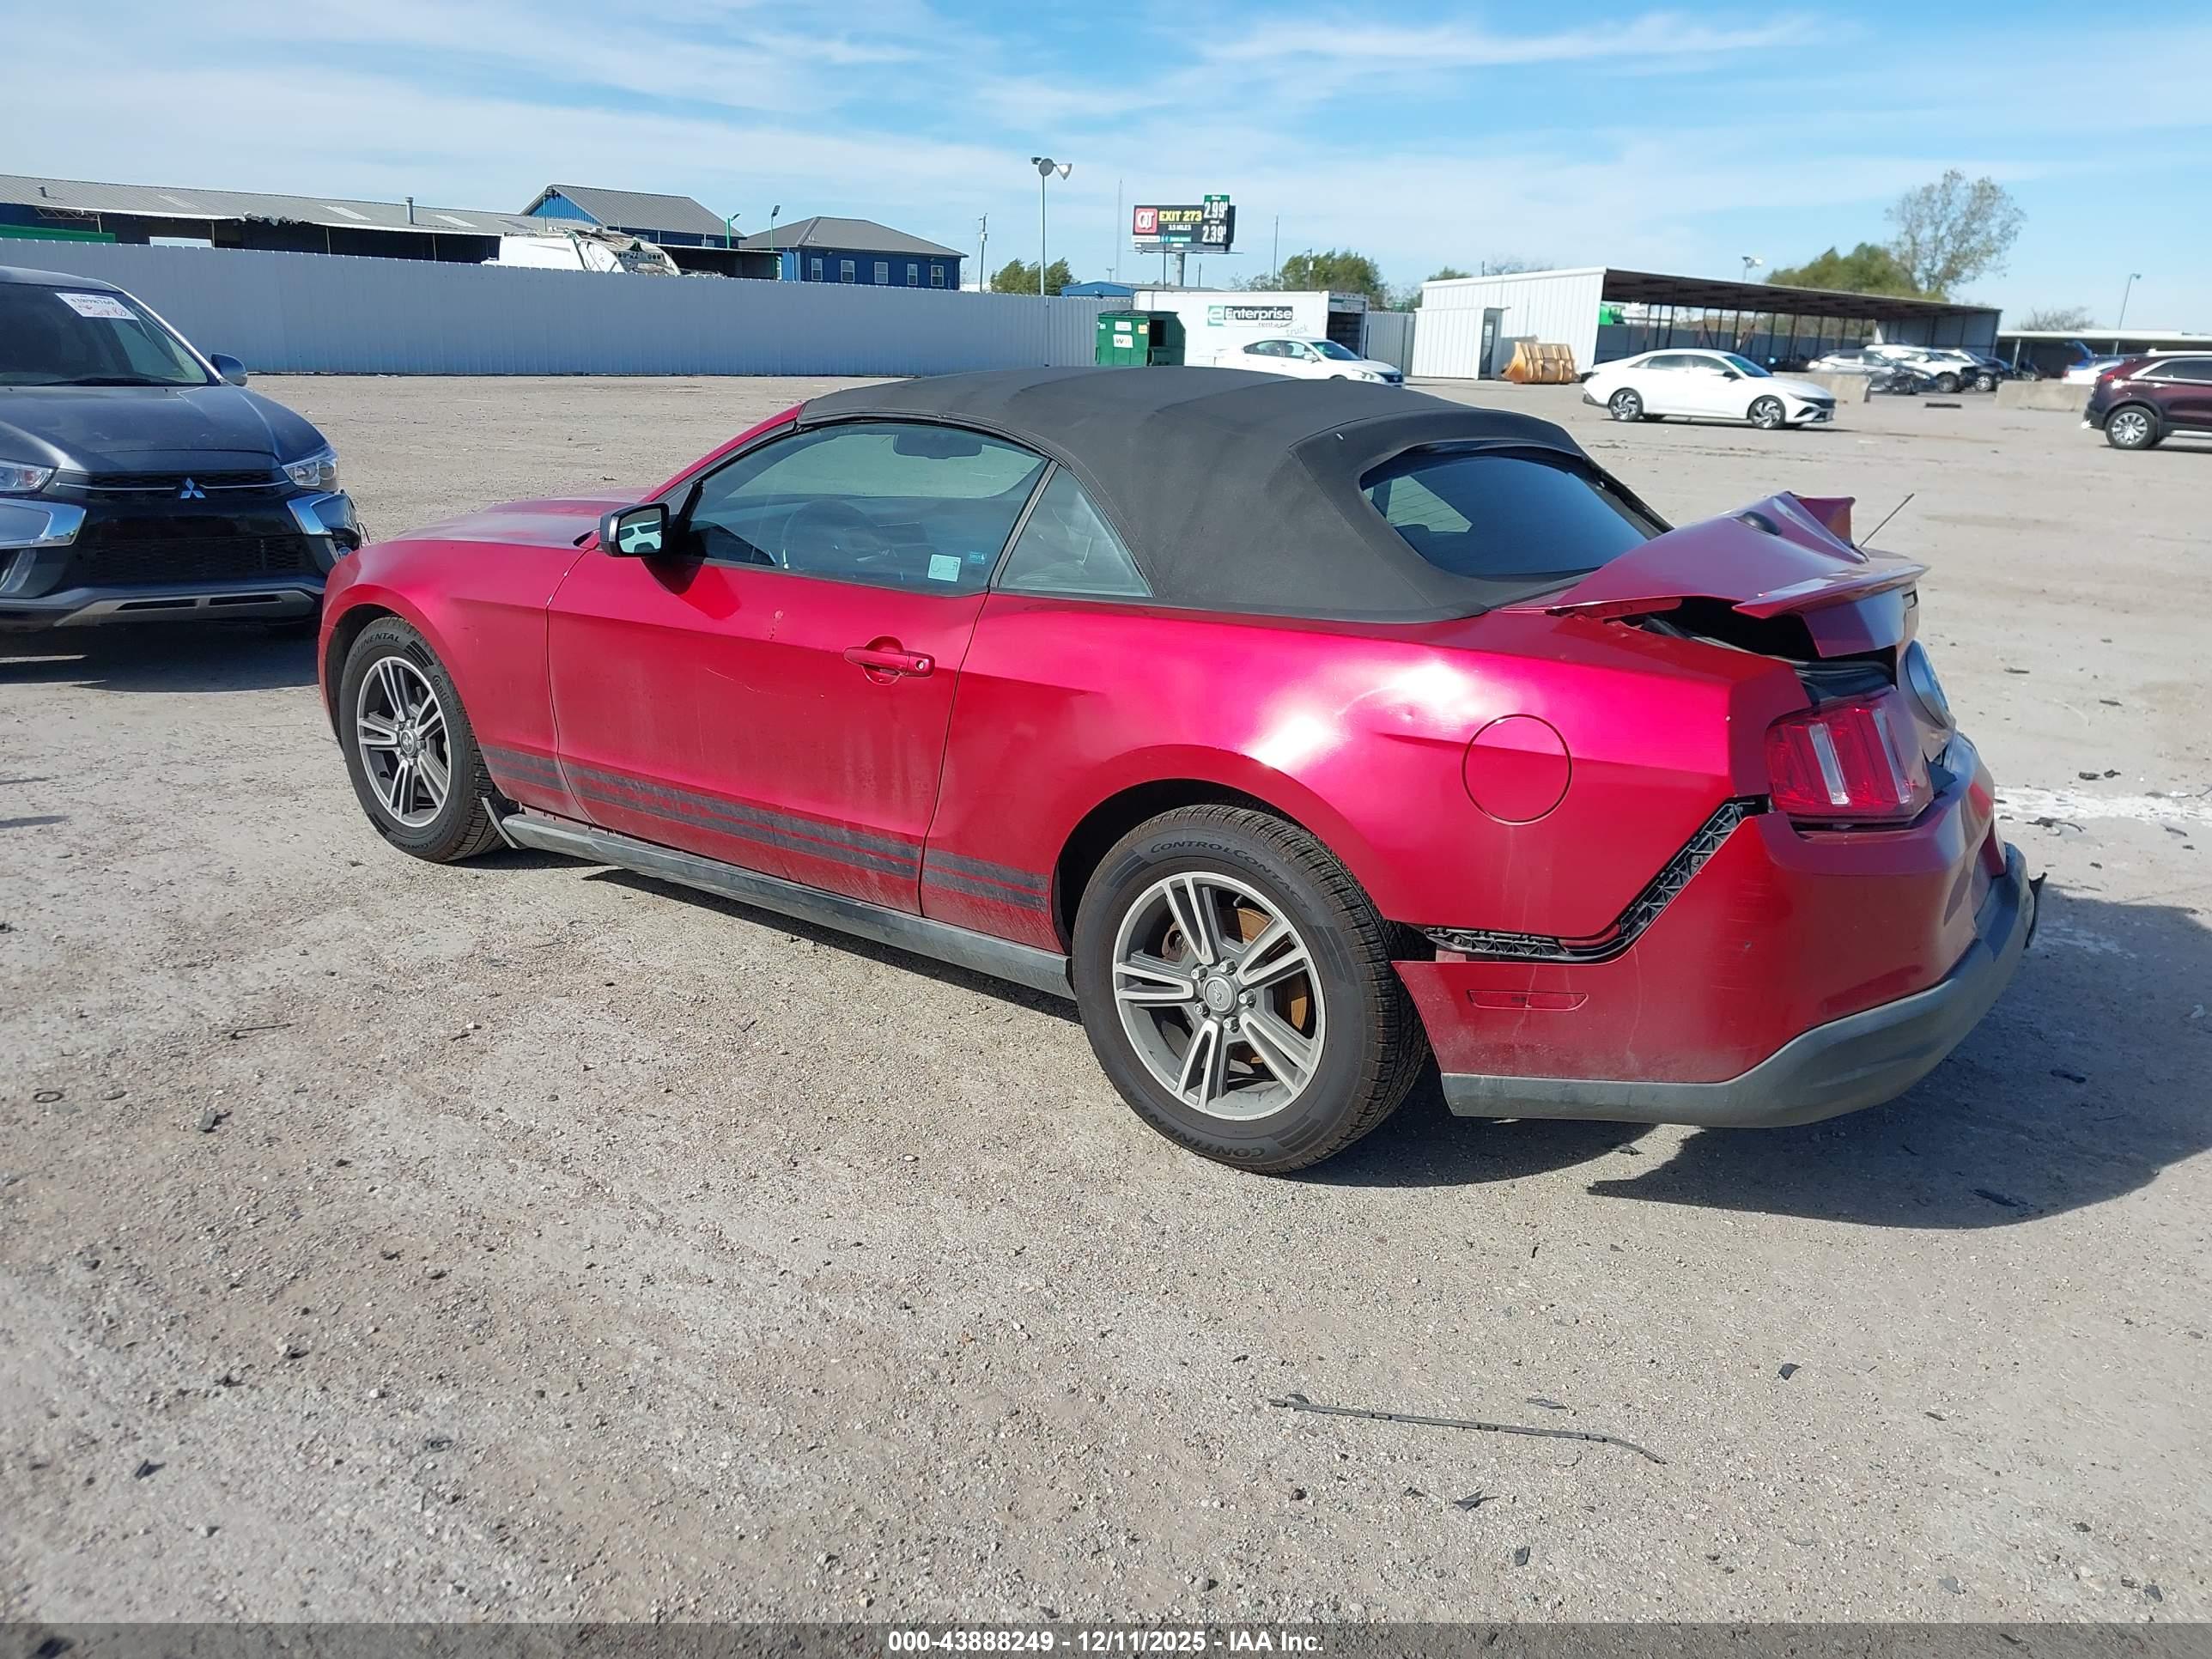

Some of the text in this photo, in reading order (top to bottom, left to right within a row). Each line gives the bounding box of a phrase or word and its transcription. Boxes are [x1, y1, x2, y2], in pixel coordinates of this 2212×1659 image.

[1137, 211, 1155, 229] QT
[1158, 210, 1202, 222] EXIT 273
[1224, 307, 1292, 320] Enterprise
